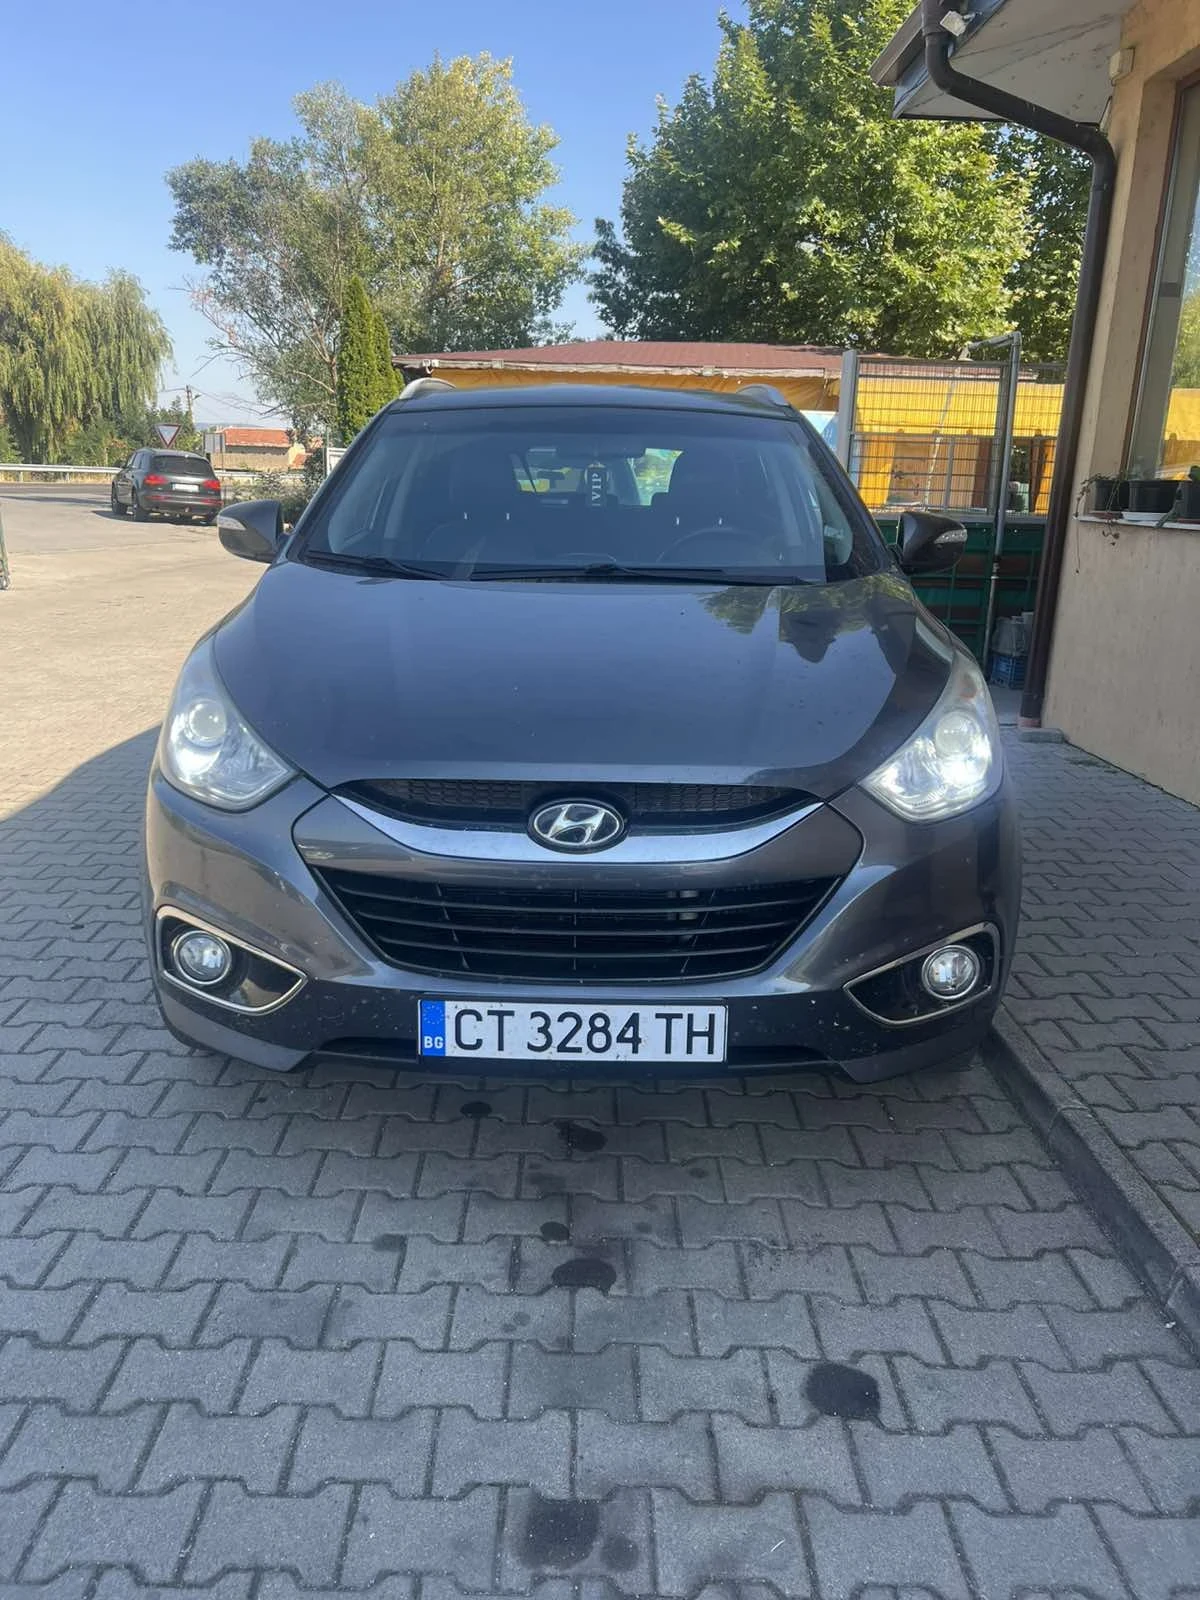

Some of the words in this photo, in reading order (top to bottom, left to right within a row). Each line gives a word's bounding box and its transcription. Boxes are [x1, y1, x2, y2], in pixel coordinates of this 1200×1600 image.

[591, 472, 601, 501] VIP
[424, 1035, 444, 1050] BG
[454, 1008, 515, 1052] CT
[527, 1011, 642, 1055] 3284
[655, 1012, 715, 1055] TH
